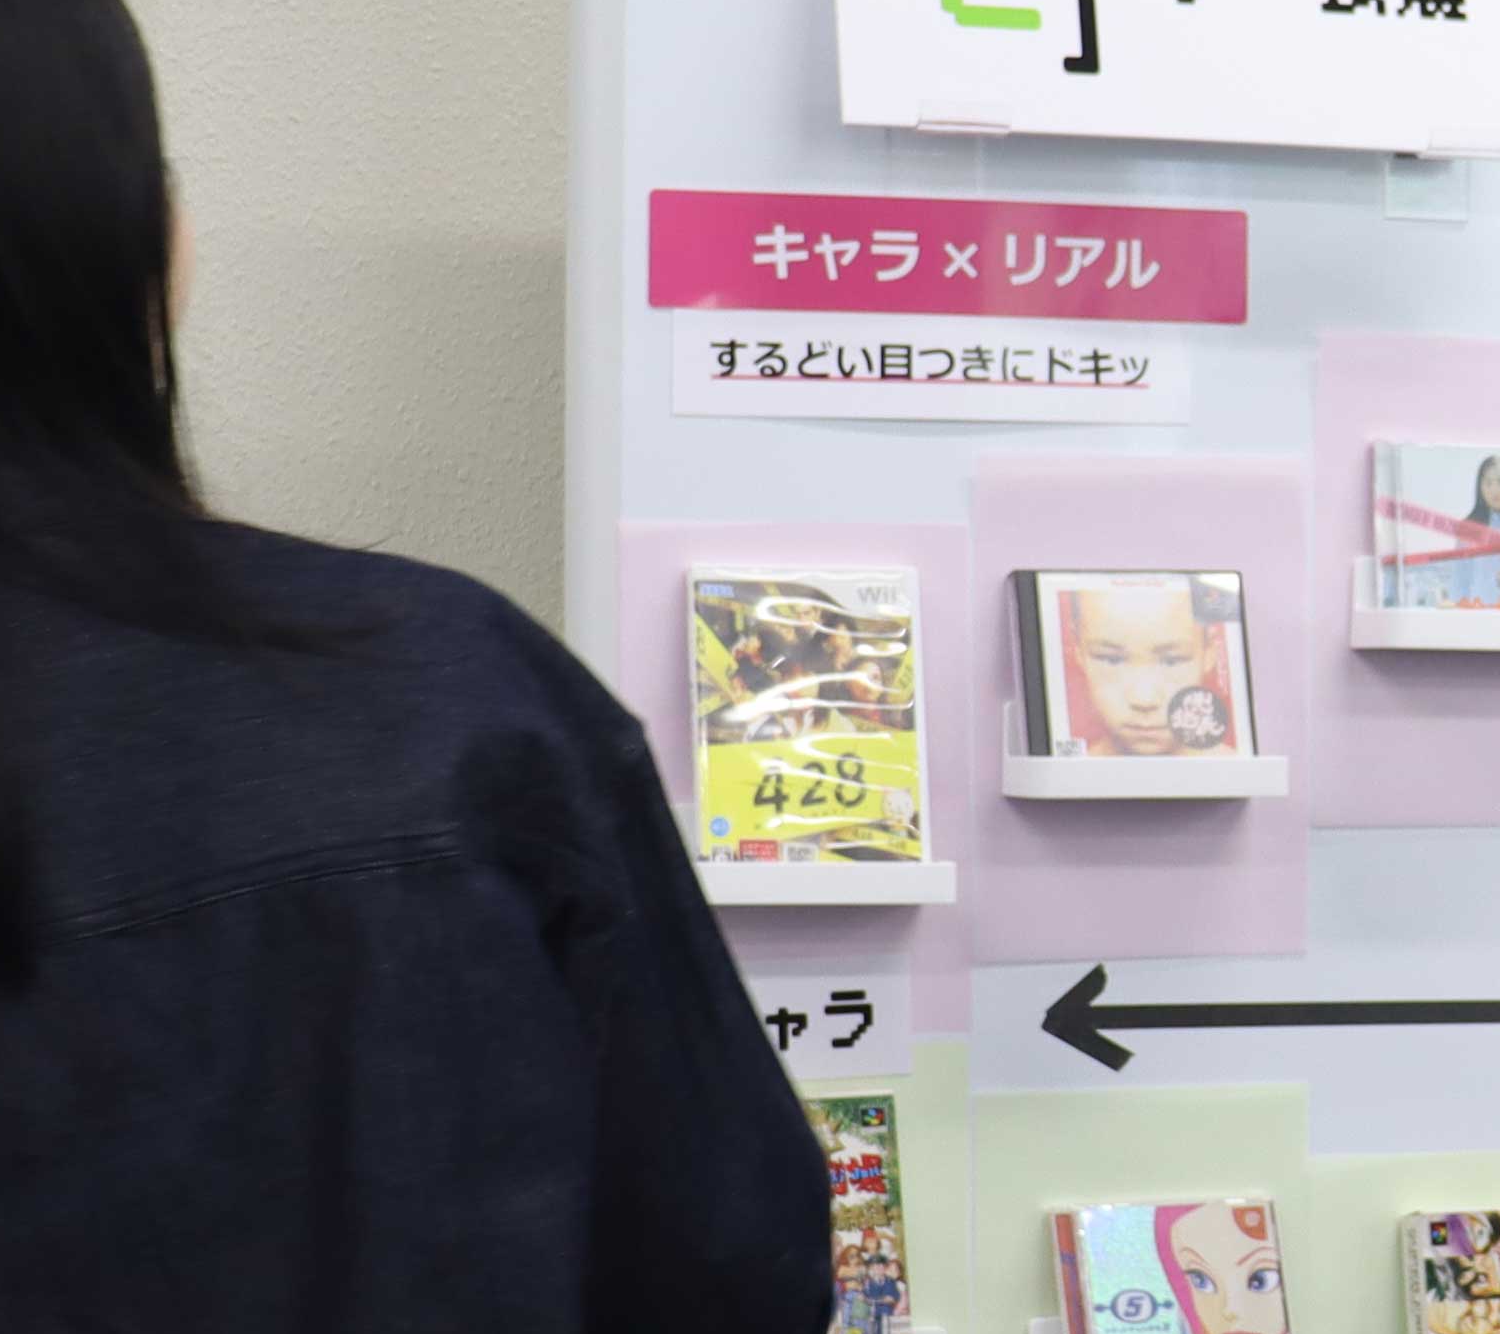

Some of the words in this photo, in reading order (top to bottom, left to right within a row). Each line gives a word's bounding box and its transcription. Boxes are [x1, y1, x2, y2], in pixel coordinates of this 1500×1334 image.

[709, 338, 1150, 387] するどい目つきにドキッ
[856, 586, 899, 604] Wii
[753, 751, 868, 814] 428
[765, 990, 874, 1051] ャラ
